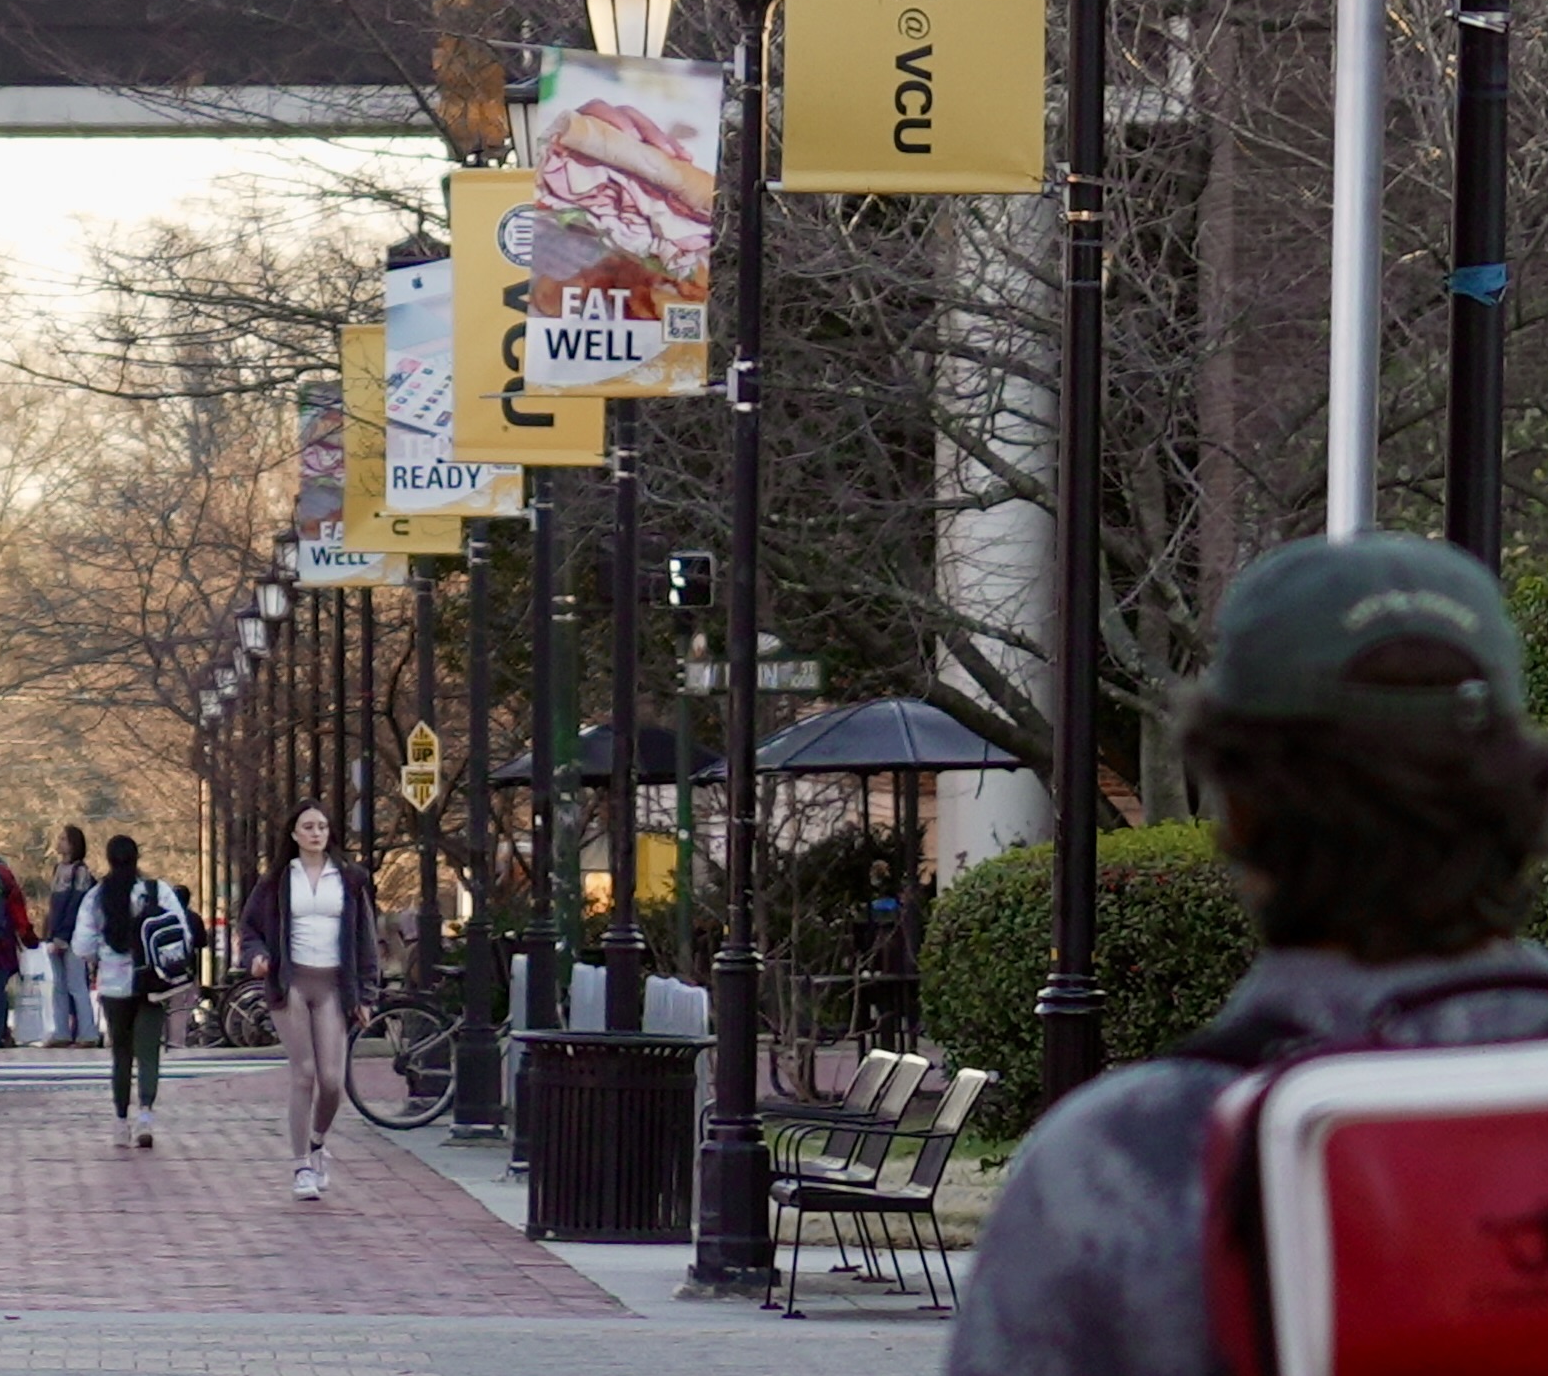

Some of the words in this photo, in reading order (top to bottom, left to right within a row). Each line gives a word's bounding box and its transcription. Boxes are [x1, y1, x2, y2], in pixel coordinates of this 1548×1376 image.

[893, 42, 934, 155] VCU
[562, 286, 632, 321] EAT
[544, 327, 643, 361] WELL
[392, 465, 483, 490] READY
